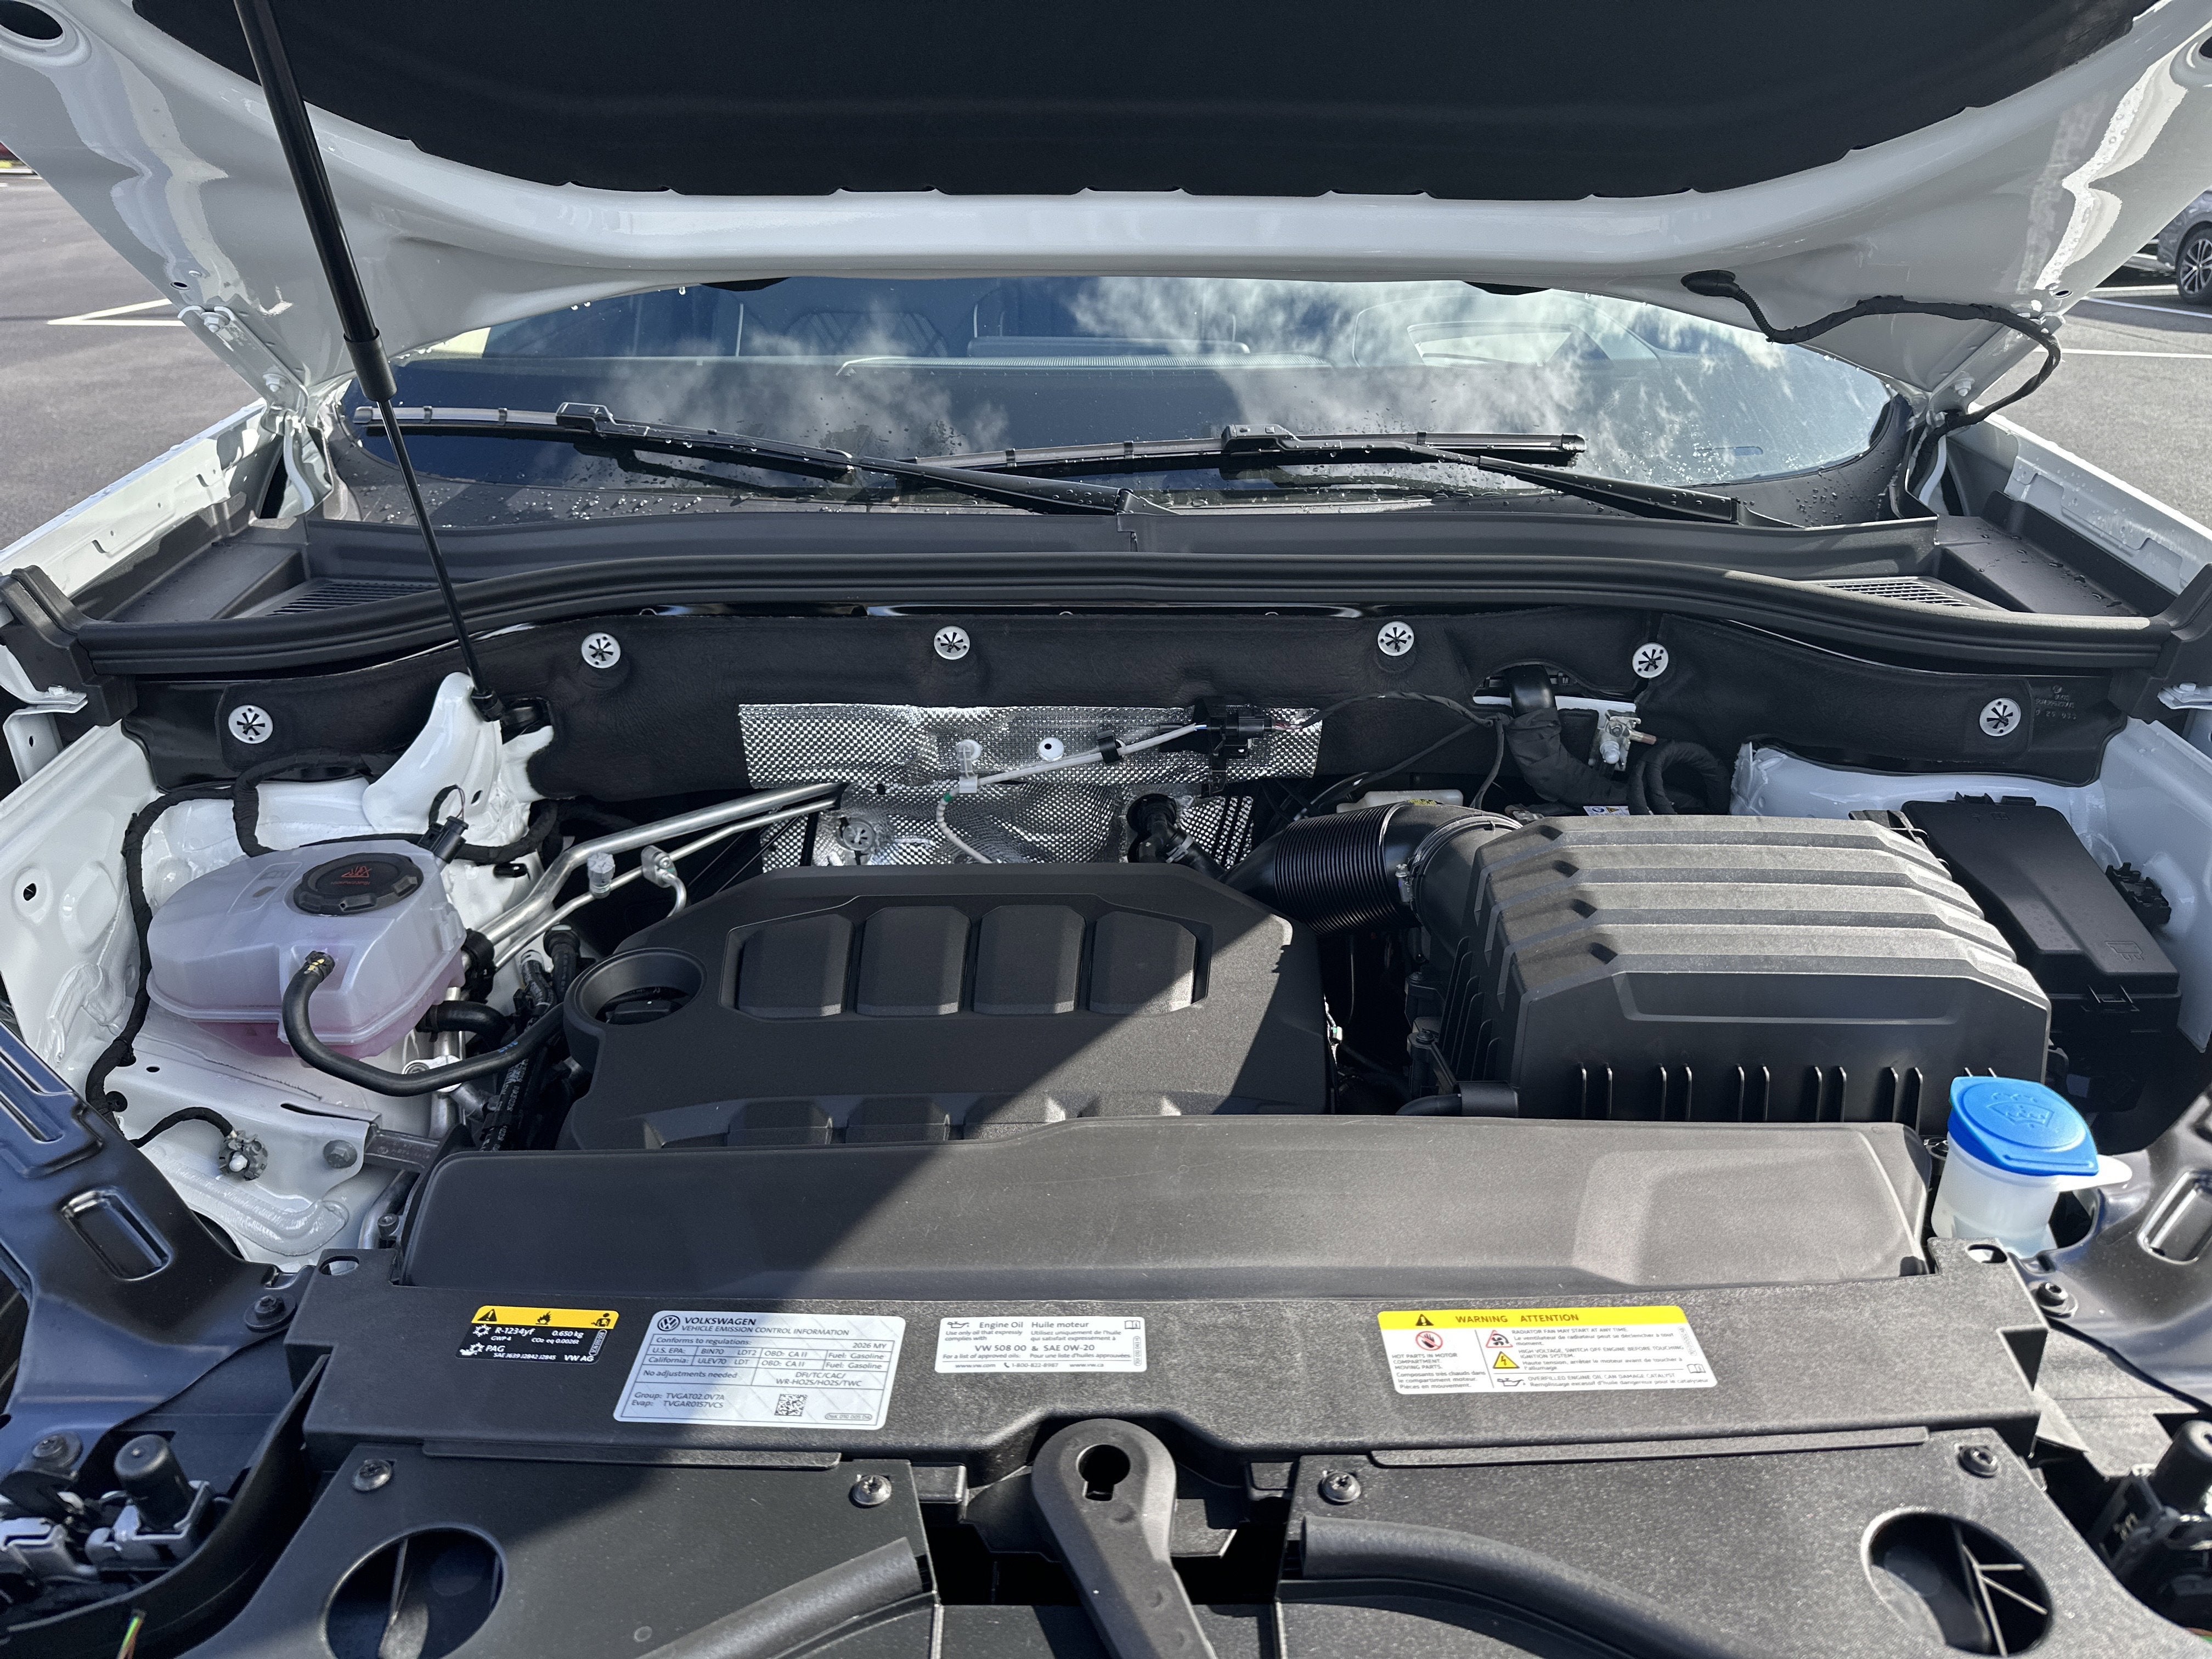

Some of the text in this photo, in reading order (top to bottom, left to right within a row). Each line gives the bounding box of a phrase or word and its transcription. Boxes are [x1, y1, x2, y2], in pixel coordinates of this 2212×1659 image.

[685, 1317, 756, 1325] VOLKSWAGEN
[1455, 1313, 1579, 1323] WARNING ATTENTION
[495, 1327, 535, 1336] R-1234yf
[656, 1370, 706, 1379] adjustments
